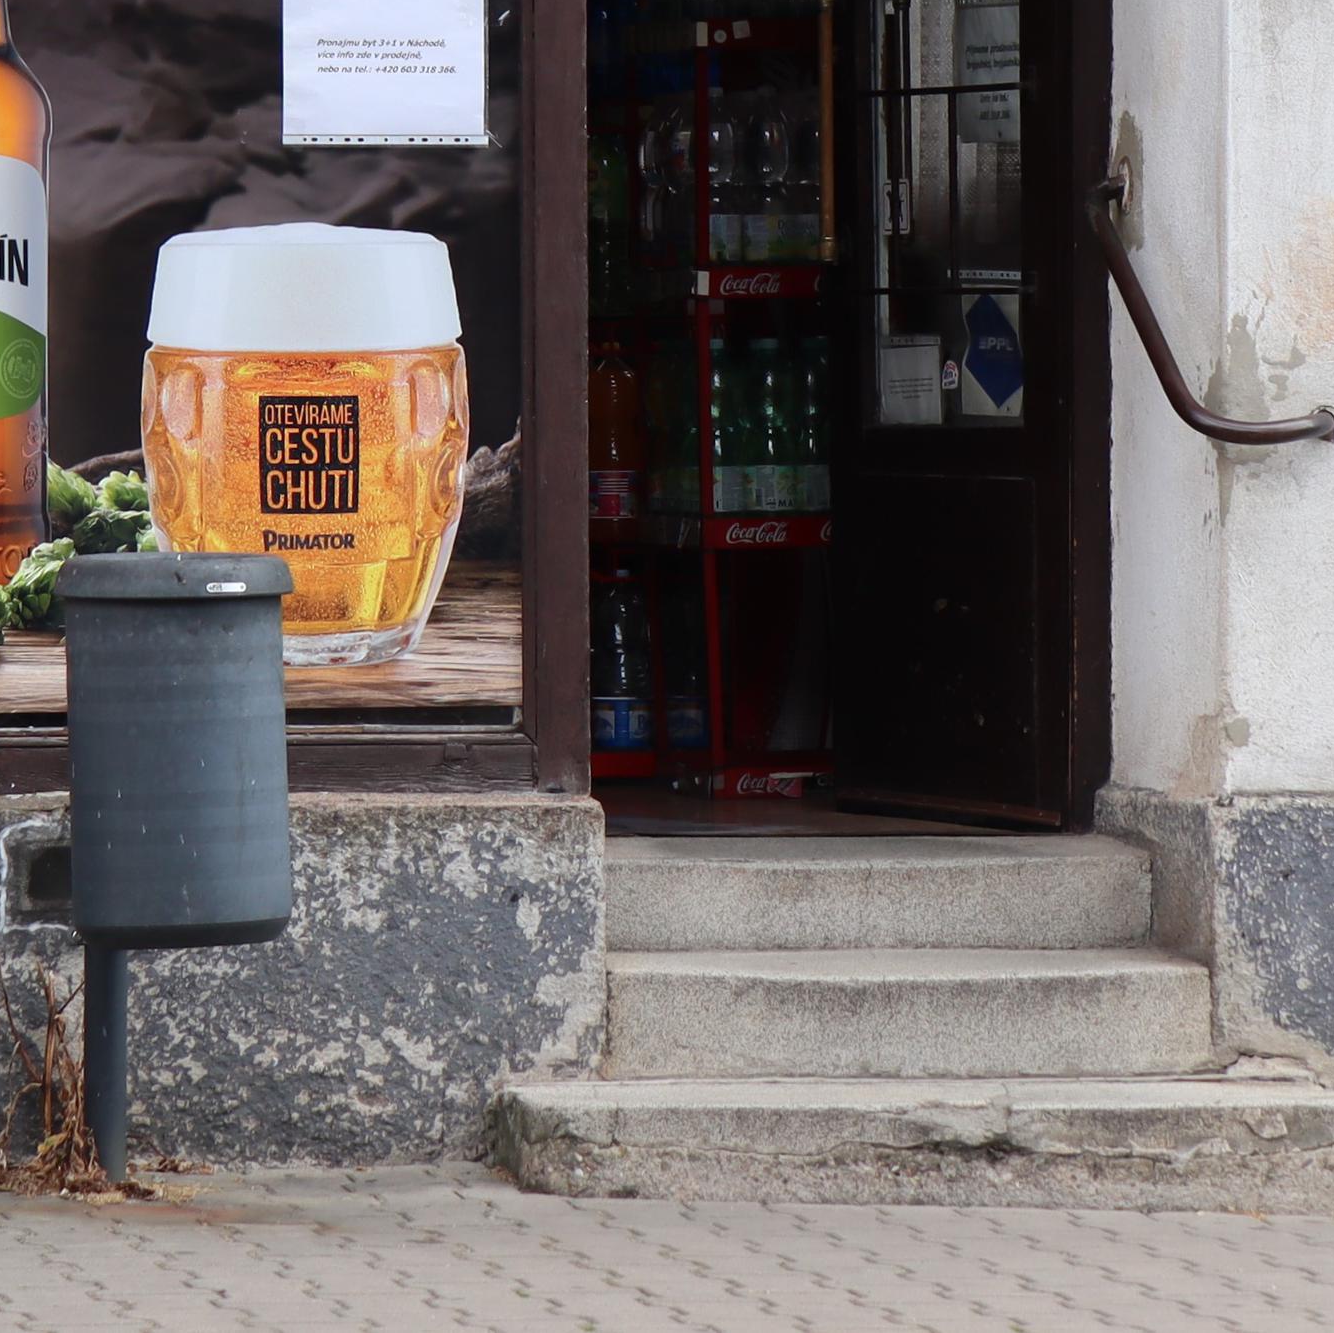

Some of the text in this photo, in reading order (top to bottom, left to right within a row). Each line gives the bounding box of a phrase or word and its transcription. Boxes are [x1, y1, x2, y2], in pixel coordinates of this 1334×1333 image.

[317, 38, 360, 48] Pronajmu
[362, 38, 376, 48] byt
[378, 39, 397, 47] 3+1
[406, 38, 447, 48] Náchodě,
[317, 50, 335, 59] více
[336, 50, 354, 59] info
[356, 50, 372, 59] zde
[380, 51, 423, 60] prodejně,
[317, 65, 339, 73] nebo
[375, 65, 399, 74] +420
[400, 65, 418, 74] 603
[419, 65, 437, 74] 318
[265, 402, 353, 425] OTEVÍRÁME
[266, 428, 354, 464] CESTU
[266, 470, 354, 509] CHUTI
[263, 529, 355, 551] PRIMATOR
[725, 522, 788, 544] Coca-Cola
